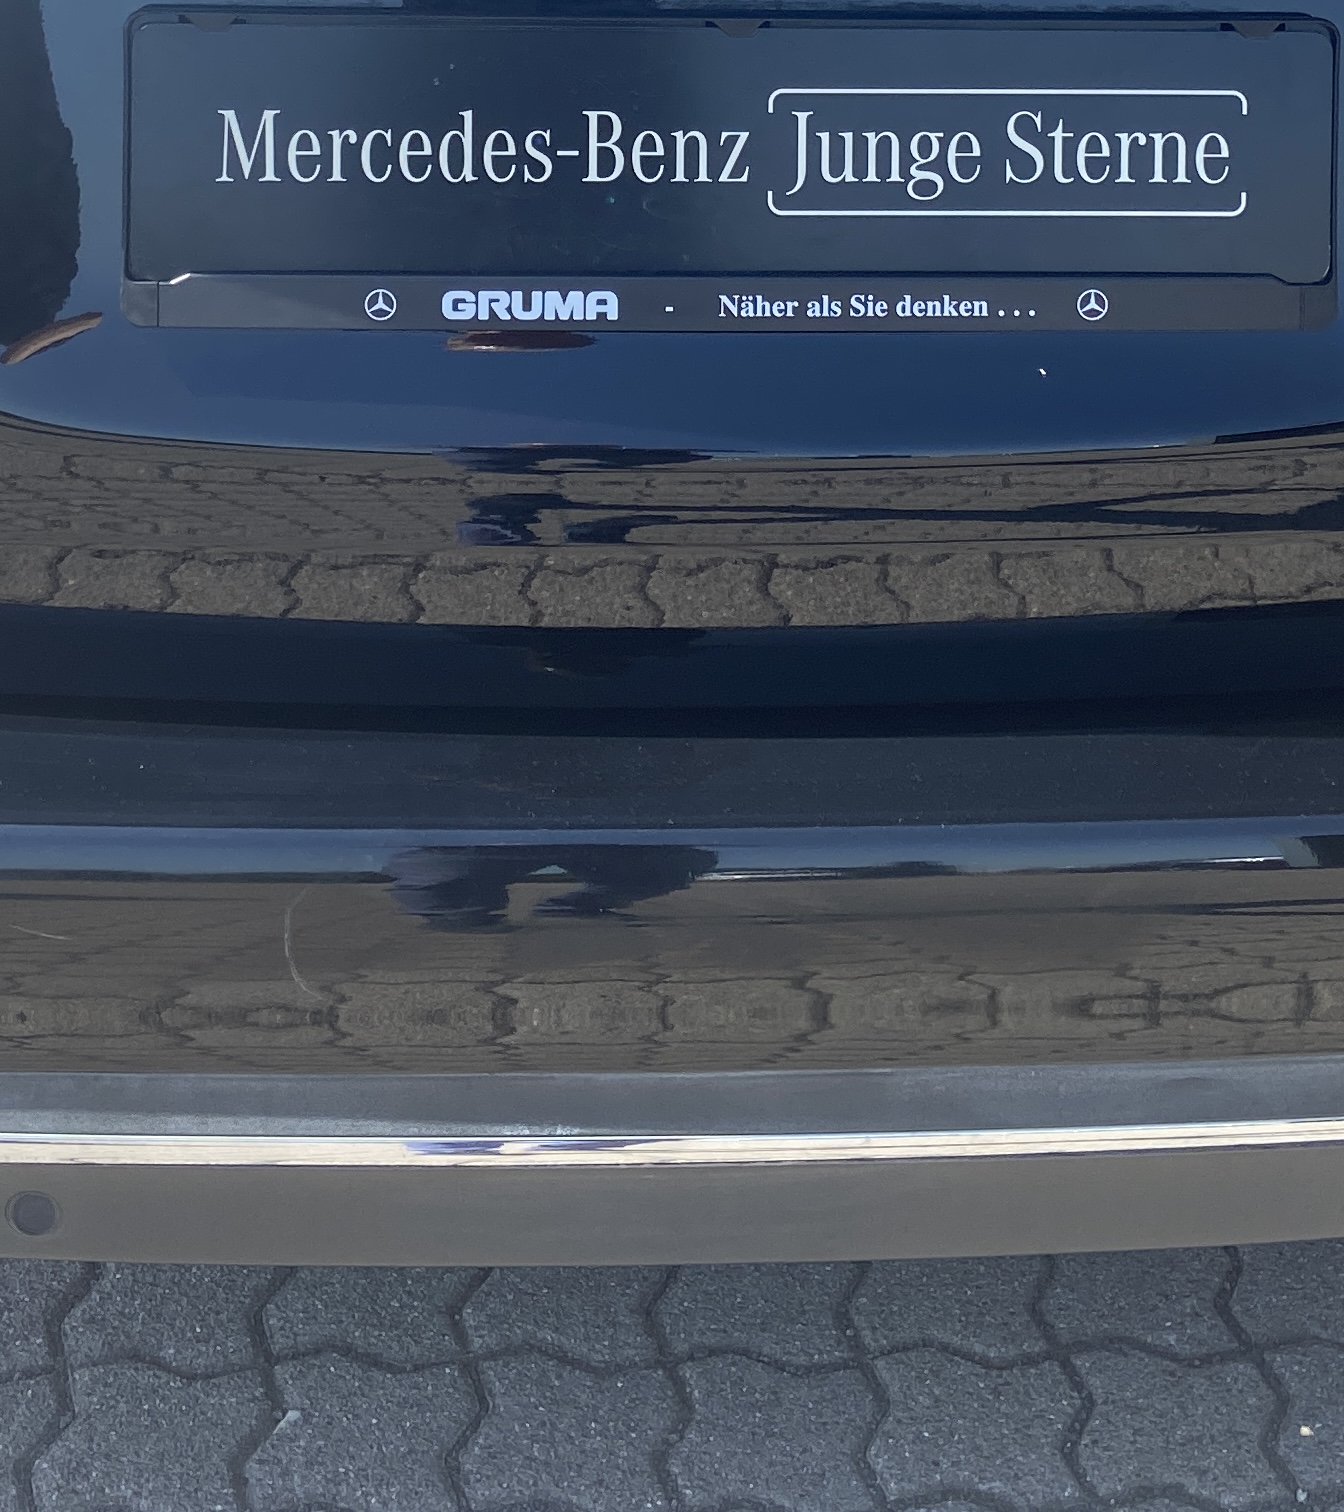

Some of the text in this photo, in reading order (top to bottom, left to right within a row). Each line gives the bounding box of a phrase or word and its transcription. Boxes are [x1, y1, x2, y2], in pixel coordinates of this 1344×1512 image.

[215, 108, 1230, 201] Mercedes-Benz Junge Sterne
[441, 289, 619, 322] GRUMA
[718, 294, 799, 319] Näher
[805, 295, 843, 319] als
[848, 295, 889, 319] Sie
[894, 295, 989, 320] denken
